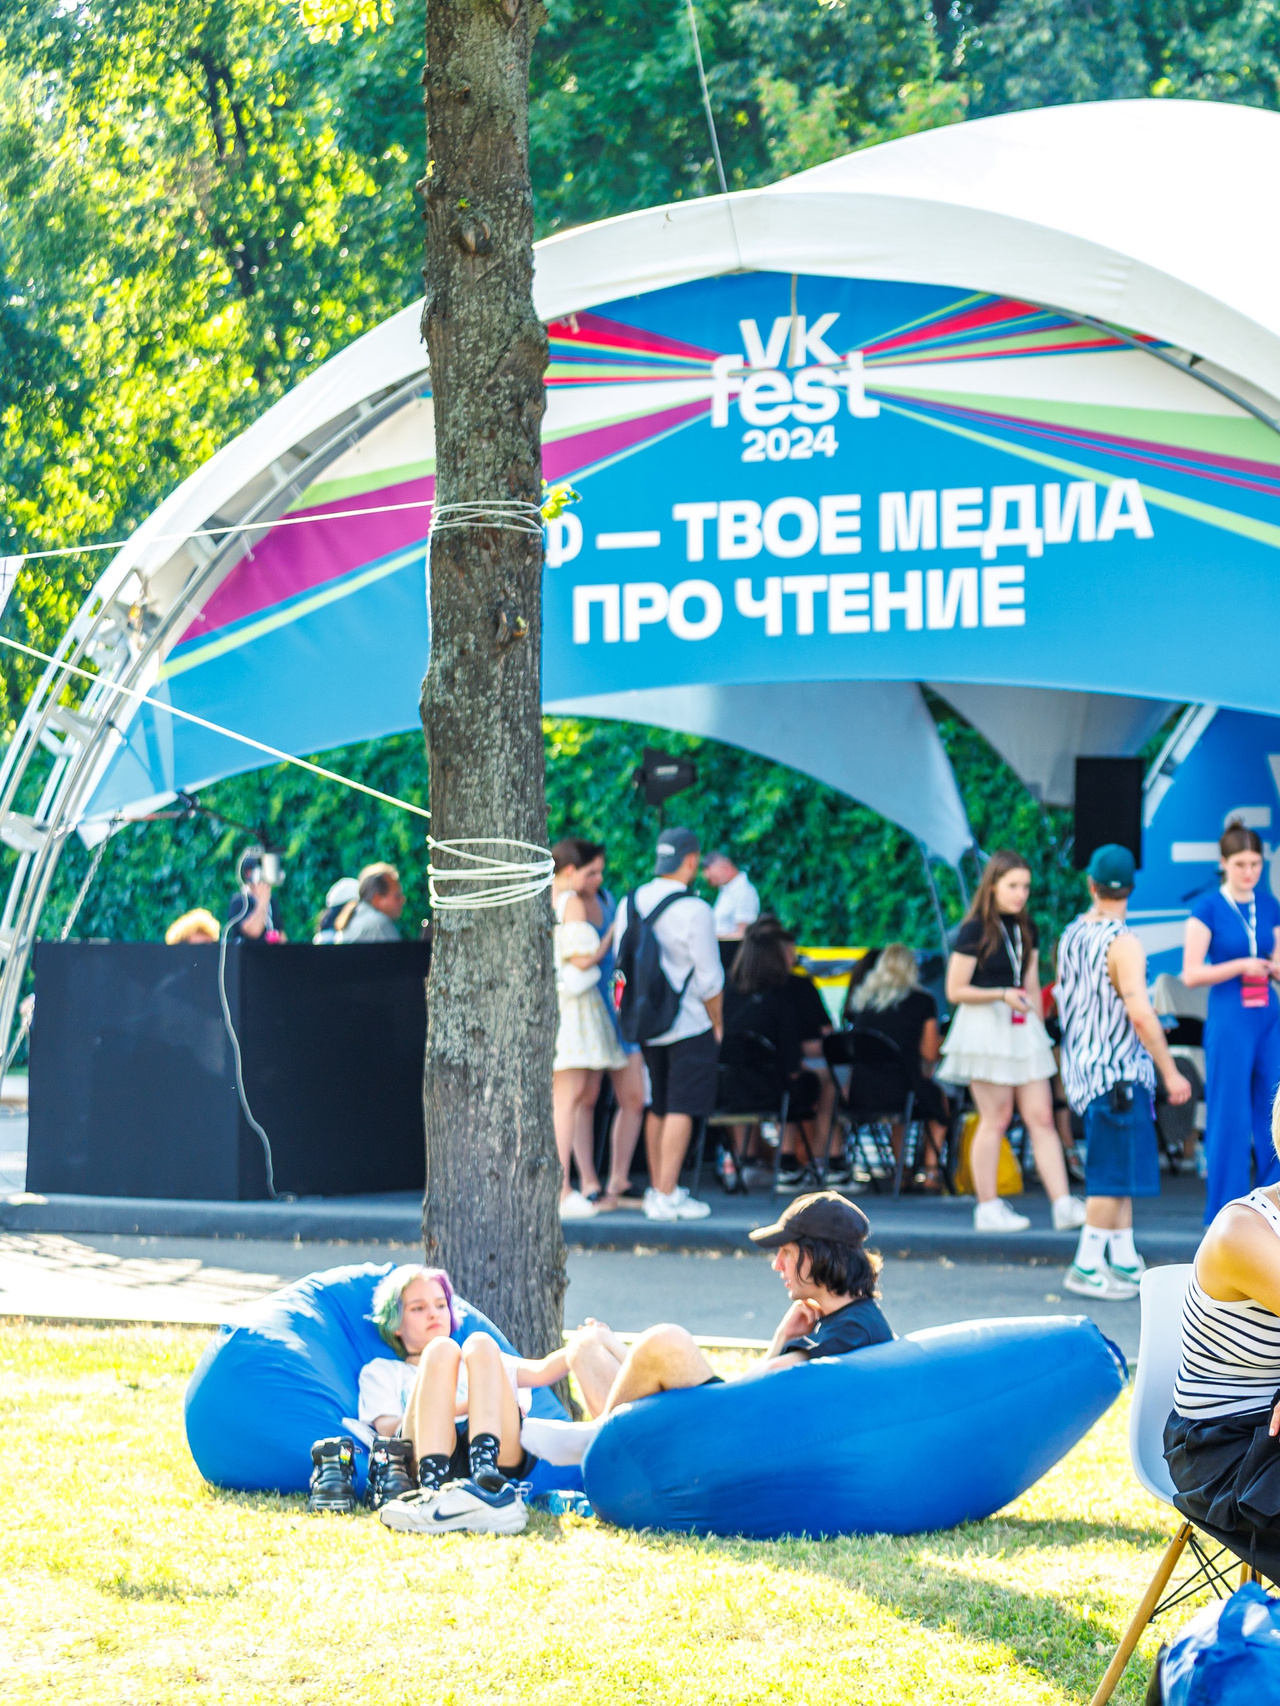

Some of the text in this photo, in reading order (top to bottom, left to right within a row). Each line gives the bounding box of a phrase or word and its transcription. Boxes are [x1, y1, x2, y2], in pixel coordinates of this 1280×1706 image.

[739, 312, 841, 369] VK
[711, 350, 881, 428] fest
[741, 425, 839, 463] 2024
[672, 493, 862, 562] ТВОЕ
[879, 478, 1155, 560] МЕДИА
[572, 564, 1026, 644] ПРО ЧТЕНИЕ
